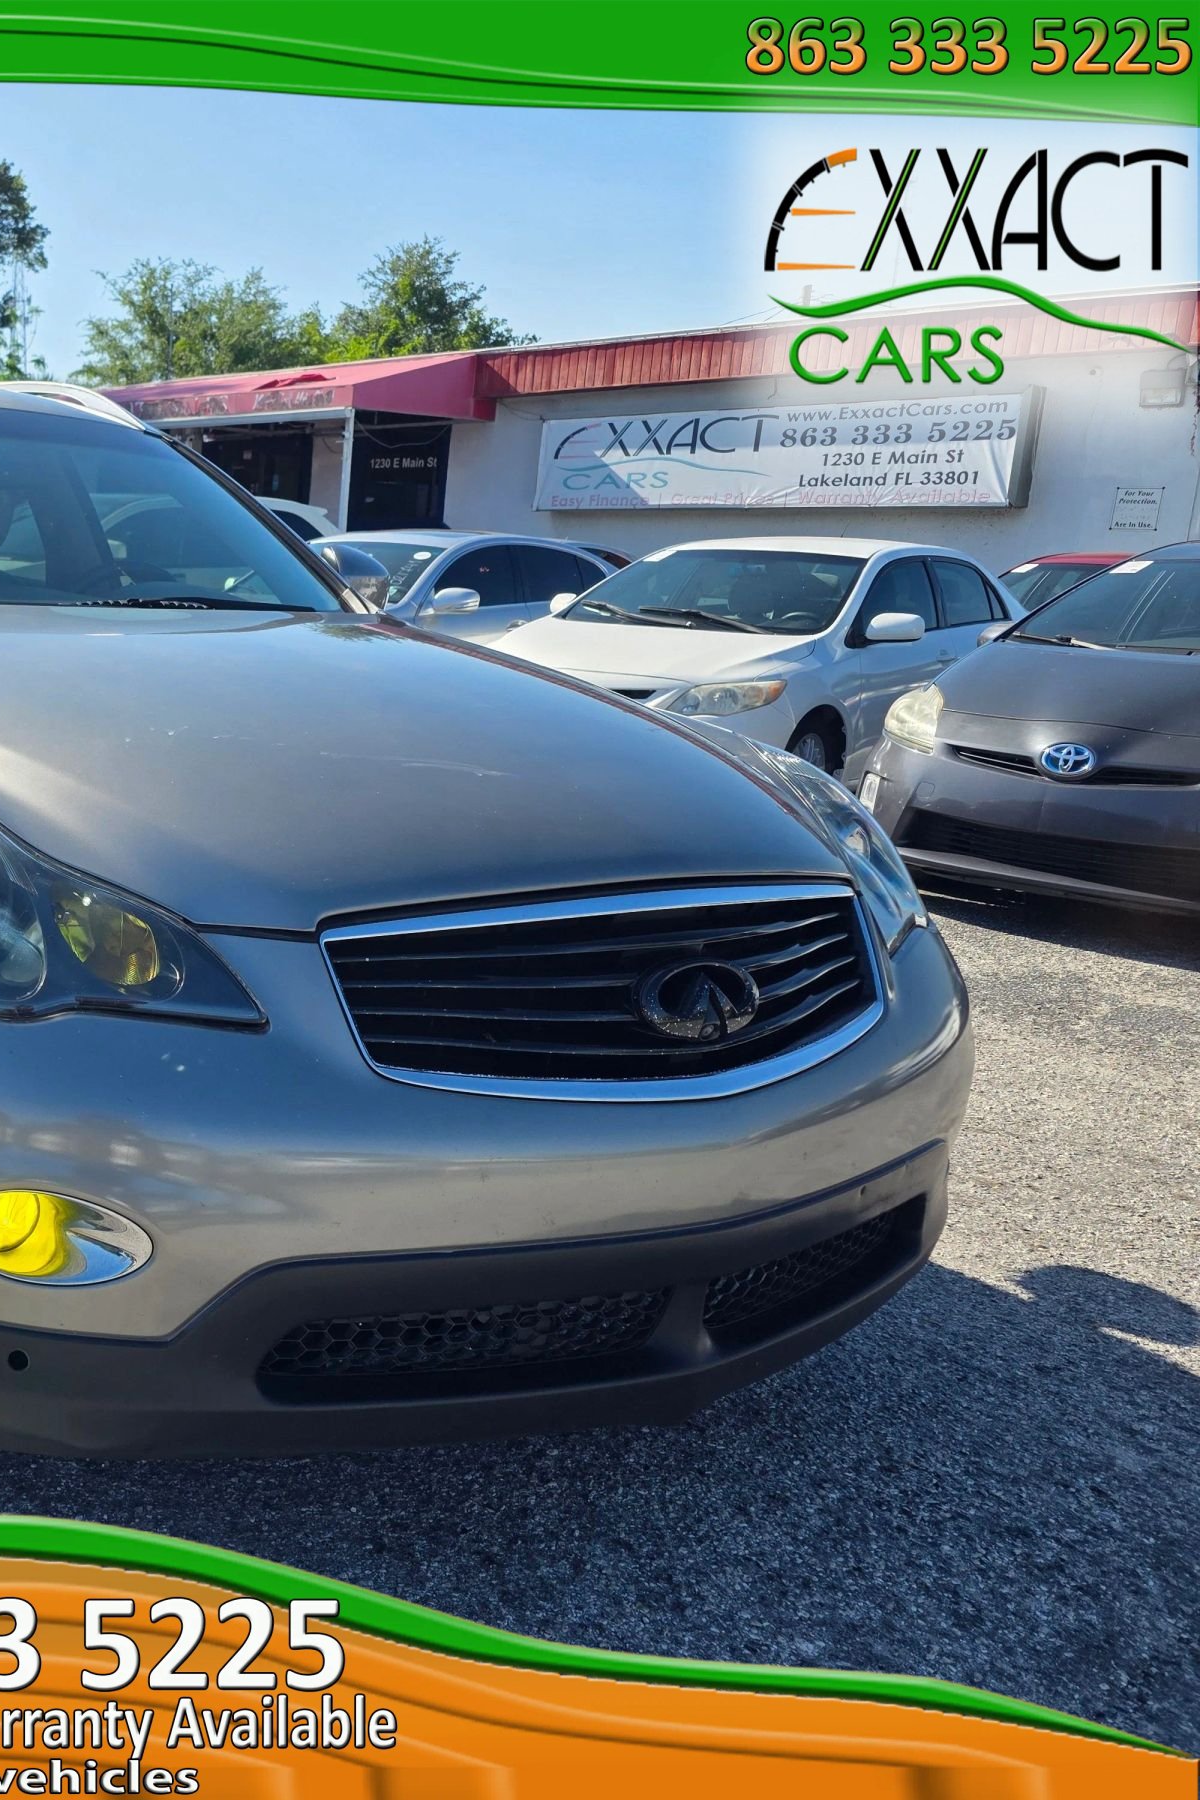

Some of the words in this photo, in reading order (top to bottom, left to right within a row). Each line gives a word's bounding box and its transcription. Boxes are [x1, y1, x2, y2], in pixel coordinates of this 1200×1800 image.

[787, 400, 1008, 423] www.ExxactCars.com
[780, 426, 837, 448] 863
[851, 423, 912, 446] 333
[927, 418, 1017, 443] 5225
[370, 458, 391, 469] 1230
[393, 457, 400, 468] E
[402, 457, 425, 468] Main
[427, 456, 438, 468] St
[822, 452, 865, 467] 1230
[871, 451, 882, 465] E
[888, 449, 938, 465] Main
[945, 449, 965, 463] St
[562, 472, 669, 490] CARS
[799, 472, 888, 488] Lakeland
[894, 472, 912, 486] FL
[919, 470, 980, 485] 33801
[551, 495, 582, 508] Easy
[589, 493, 649, 508] Finance
[799, 489, 882, 505] Warranty
[892, 487, 991, 503] Available
